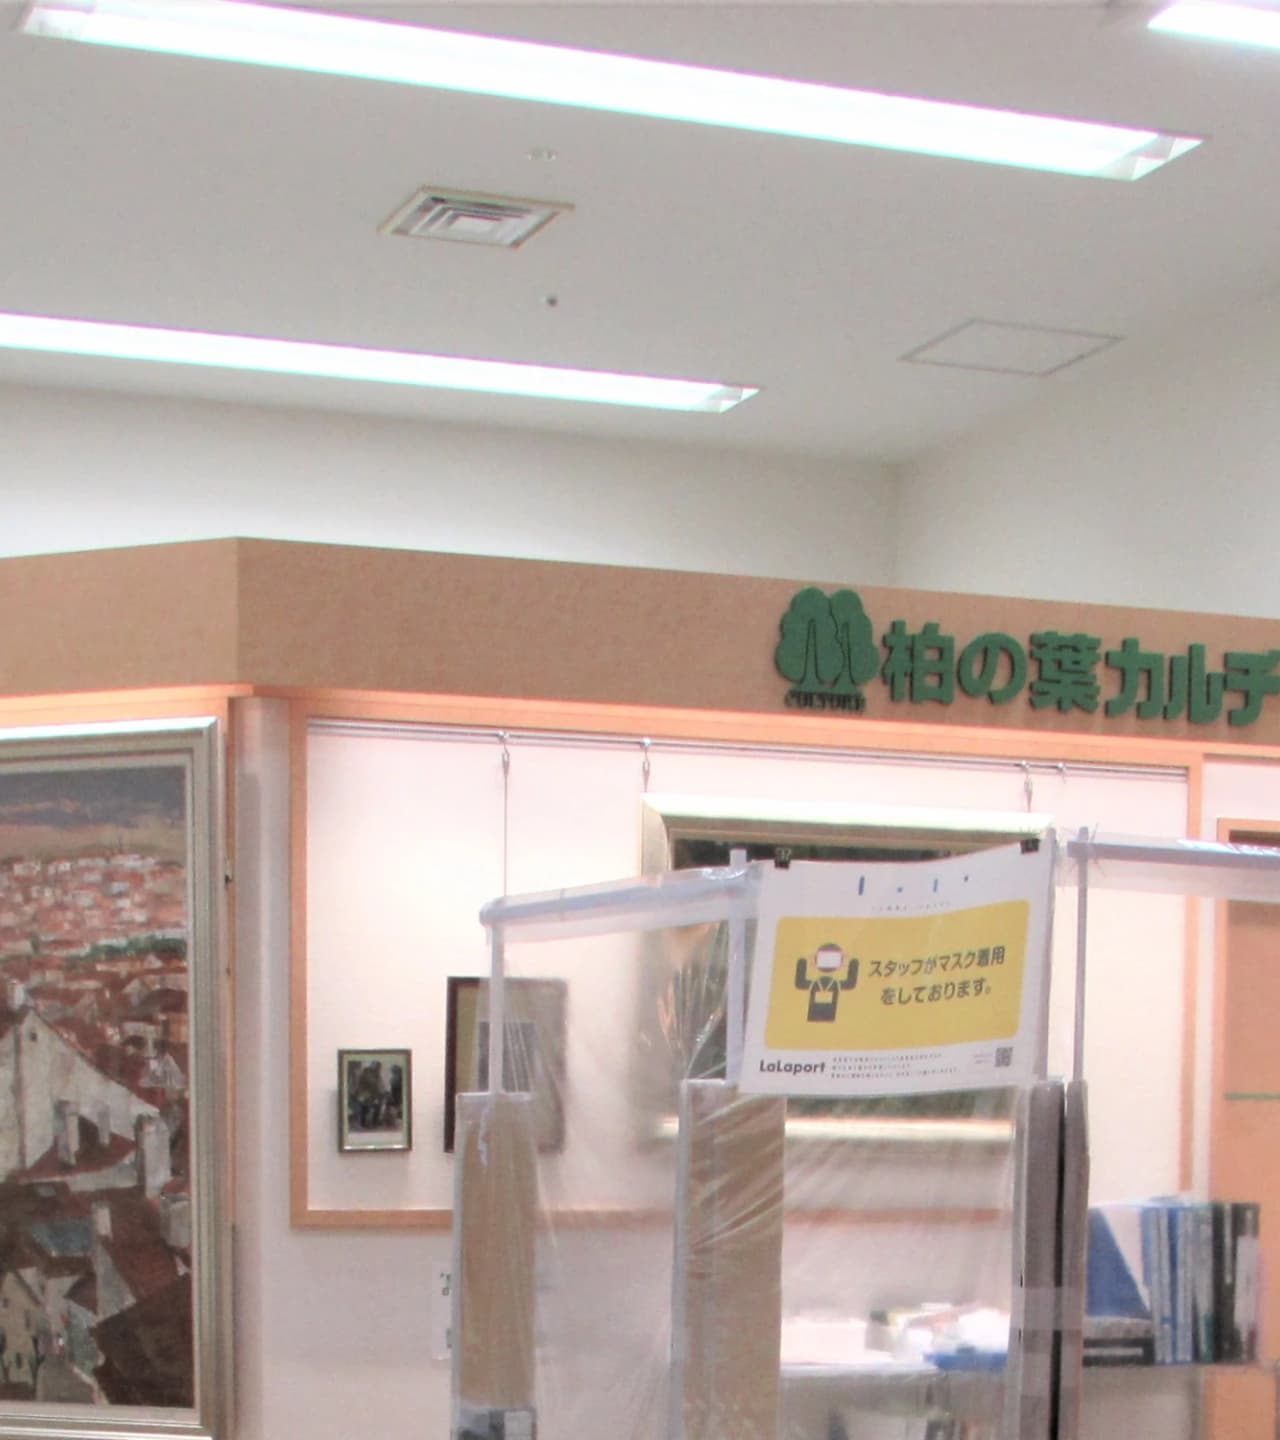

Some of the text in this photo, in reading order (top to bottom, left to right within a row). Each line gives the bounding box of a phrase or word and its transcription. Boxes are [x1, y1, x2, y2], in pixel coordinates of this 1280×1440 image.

[867, 944, 1006, 978] スタッフがマスク着用
[880, 977, 993, 1006] をしております。
[759, 1058, 826, 1076] LaLaport
